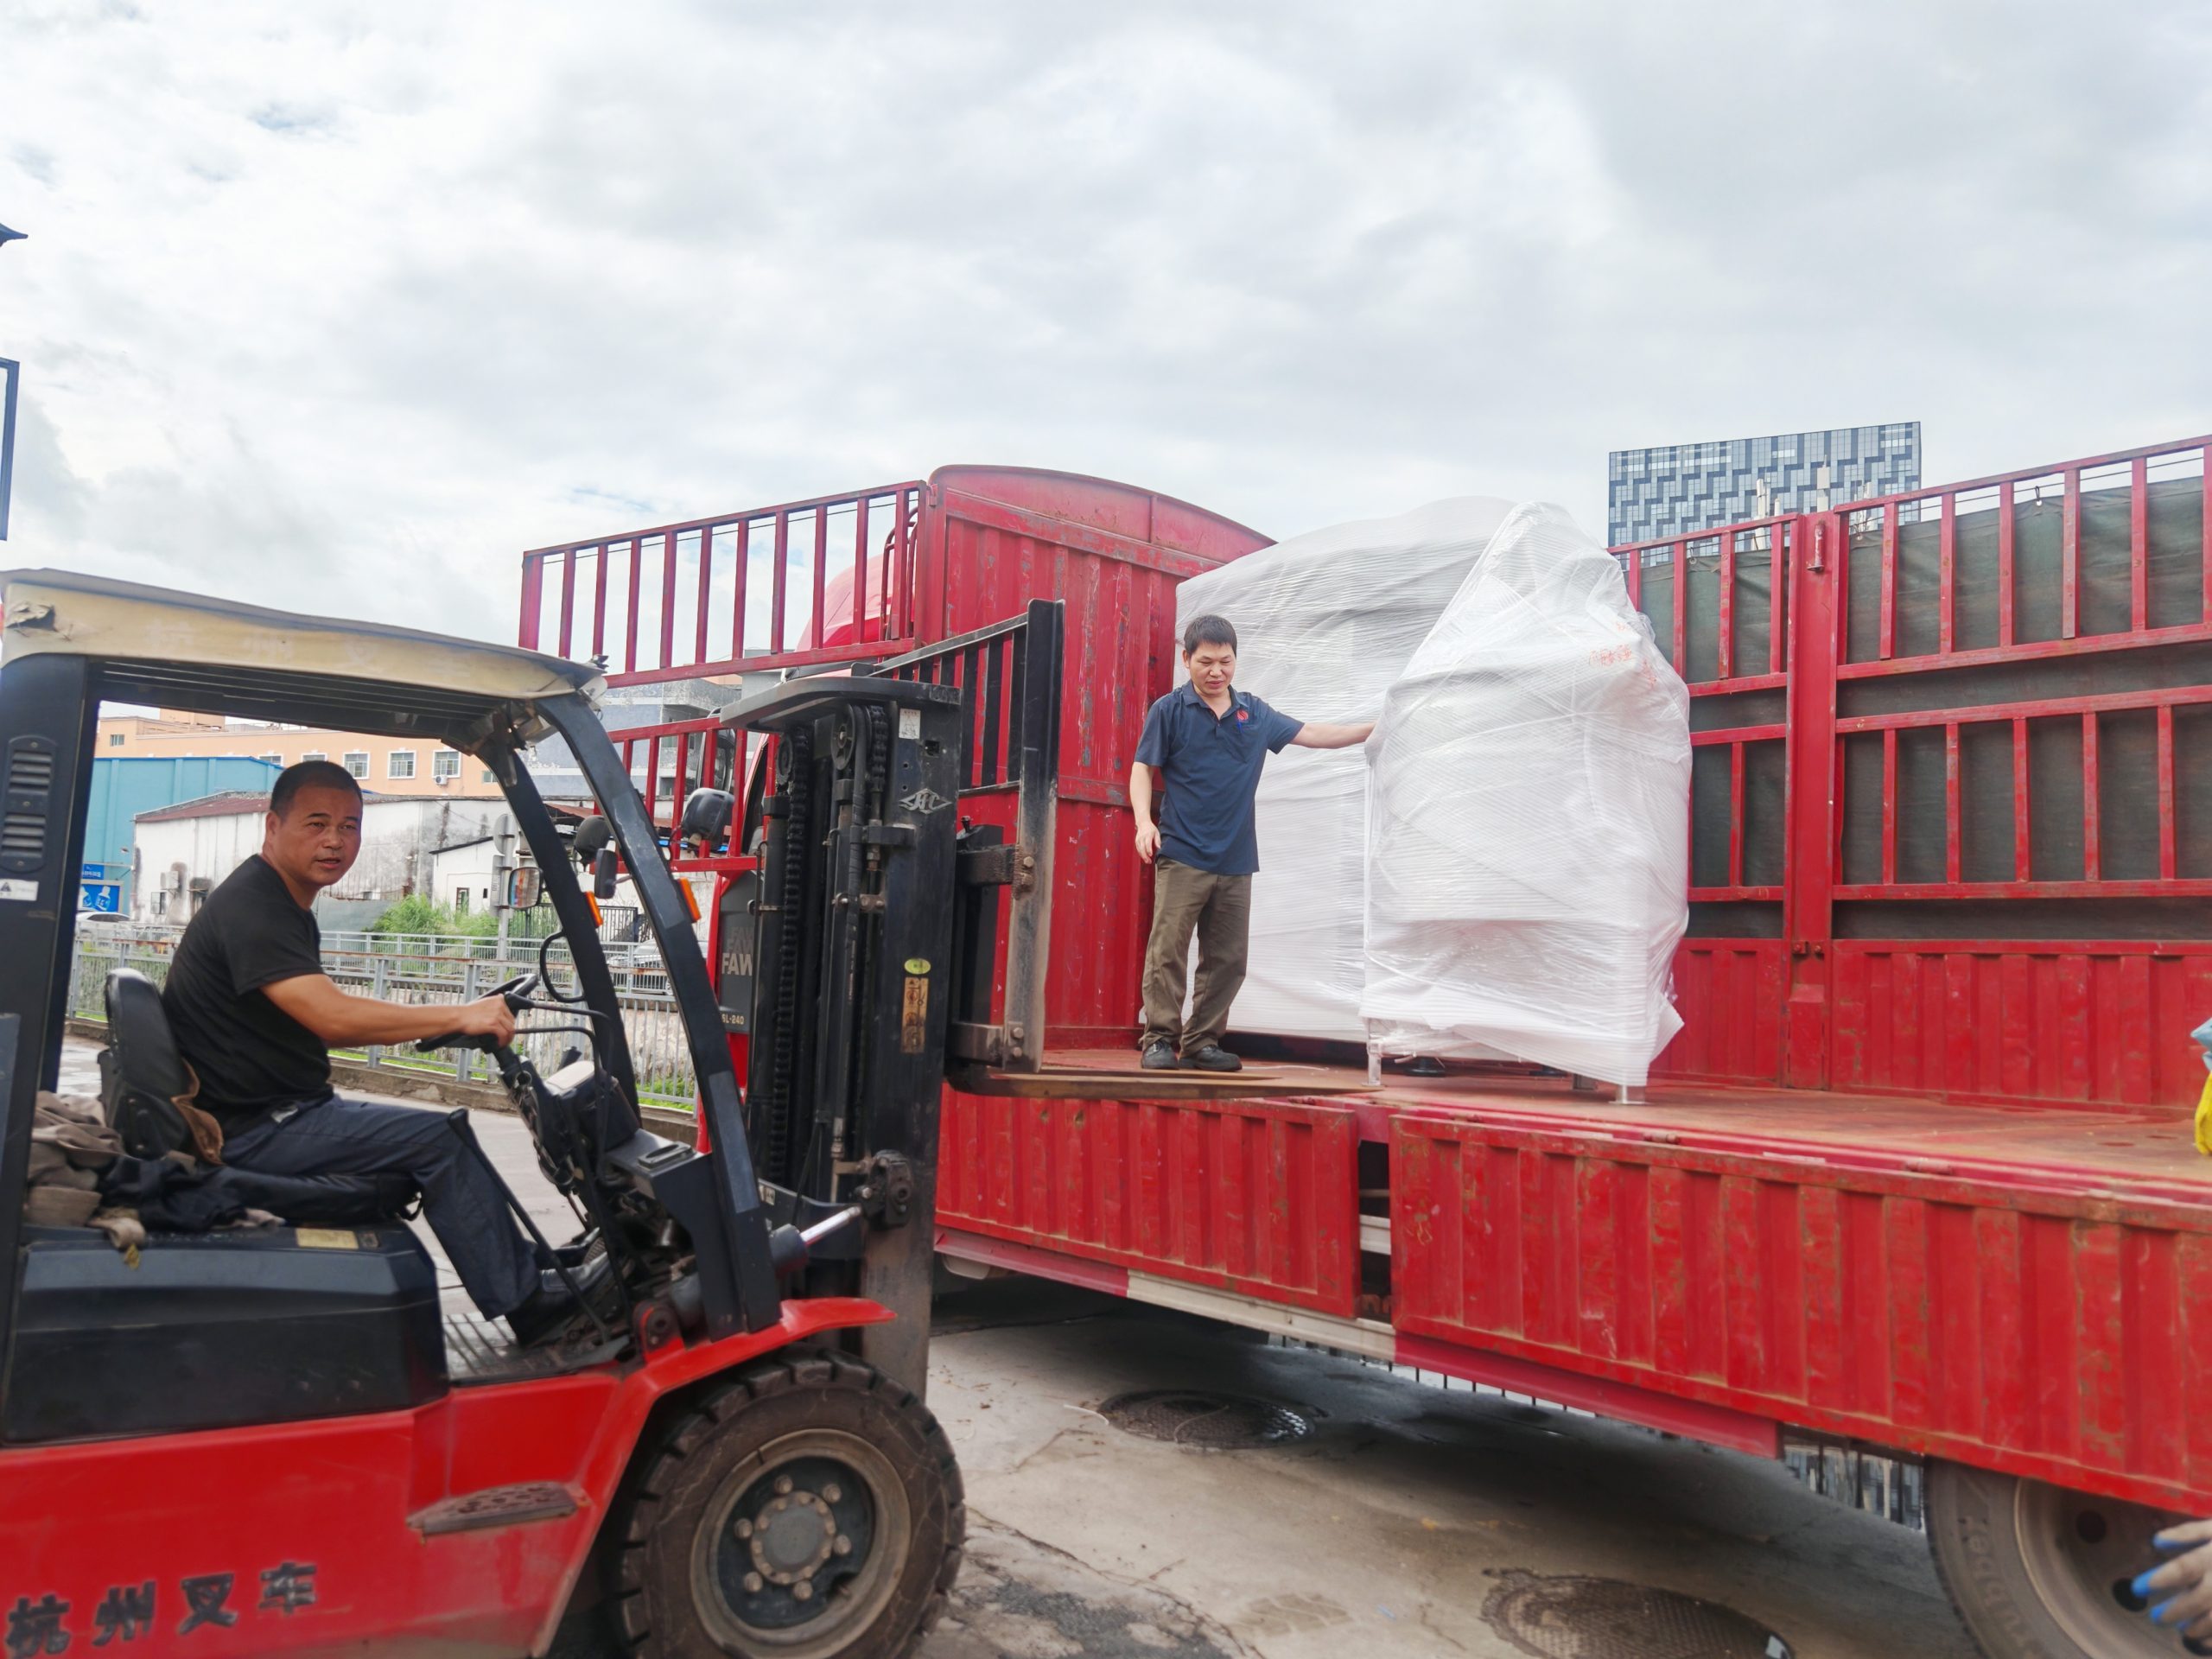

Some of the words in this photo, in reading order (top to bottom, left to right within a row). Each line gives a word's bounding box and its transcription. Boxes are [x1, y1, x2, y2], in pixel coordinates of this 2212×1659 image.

[721, 952, 753, 976] FAW
[4, 1561, 317, 1658] 杭州叉车
